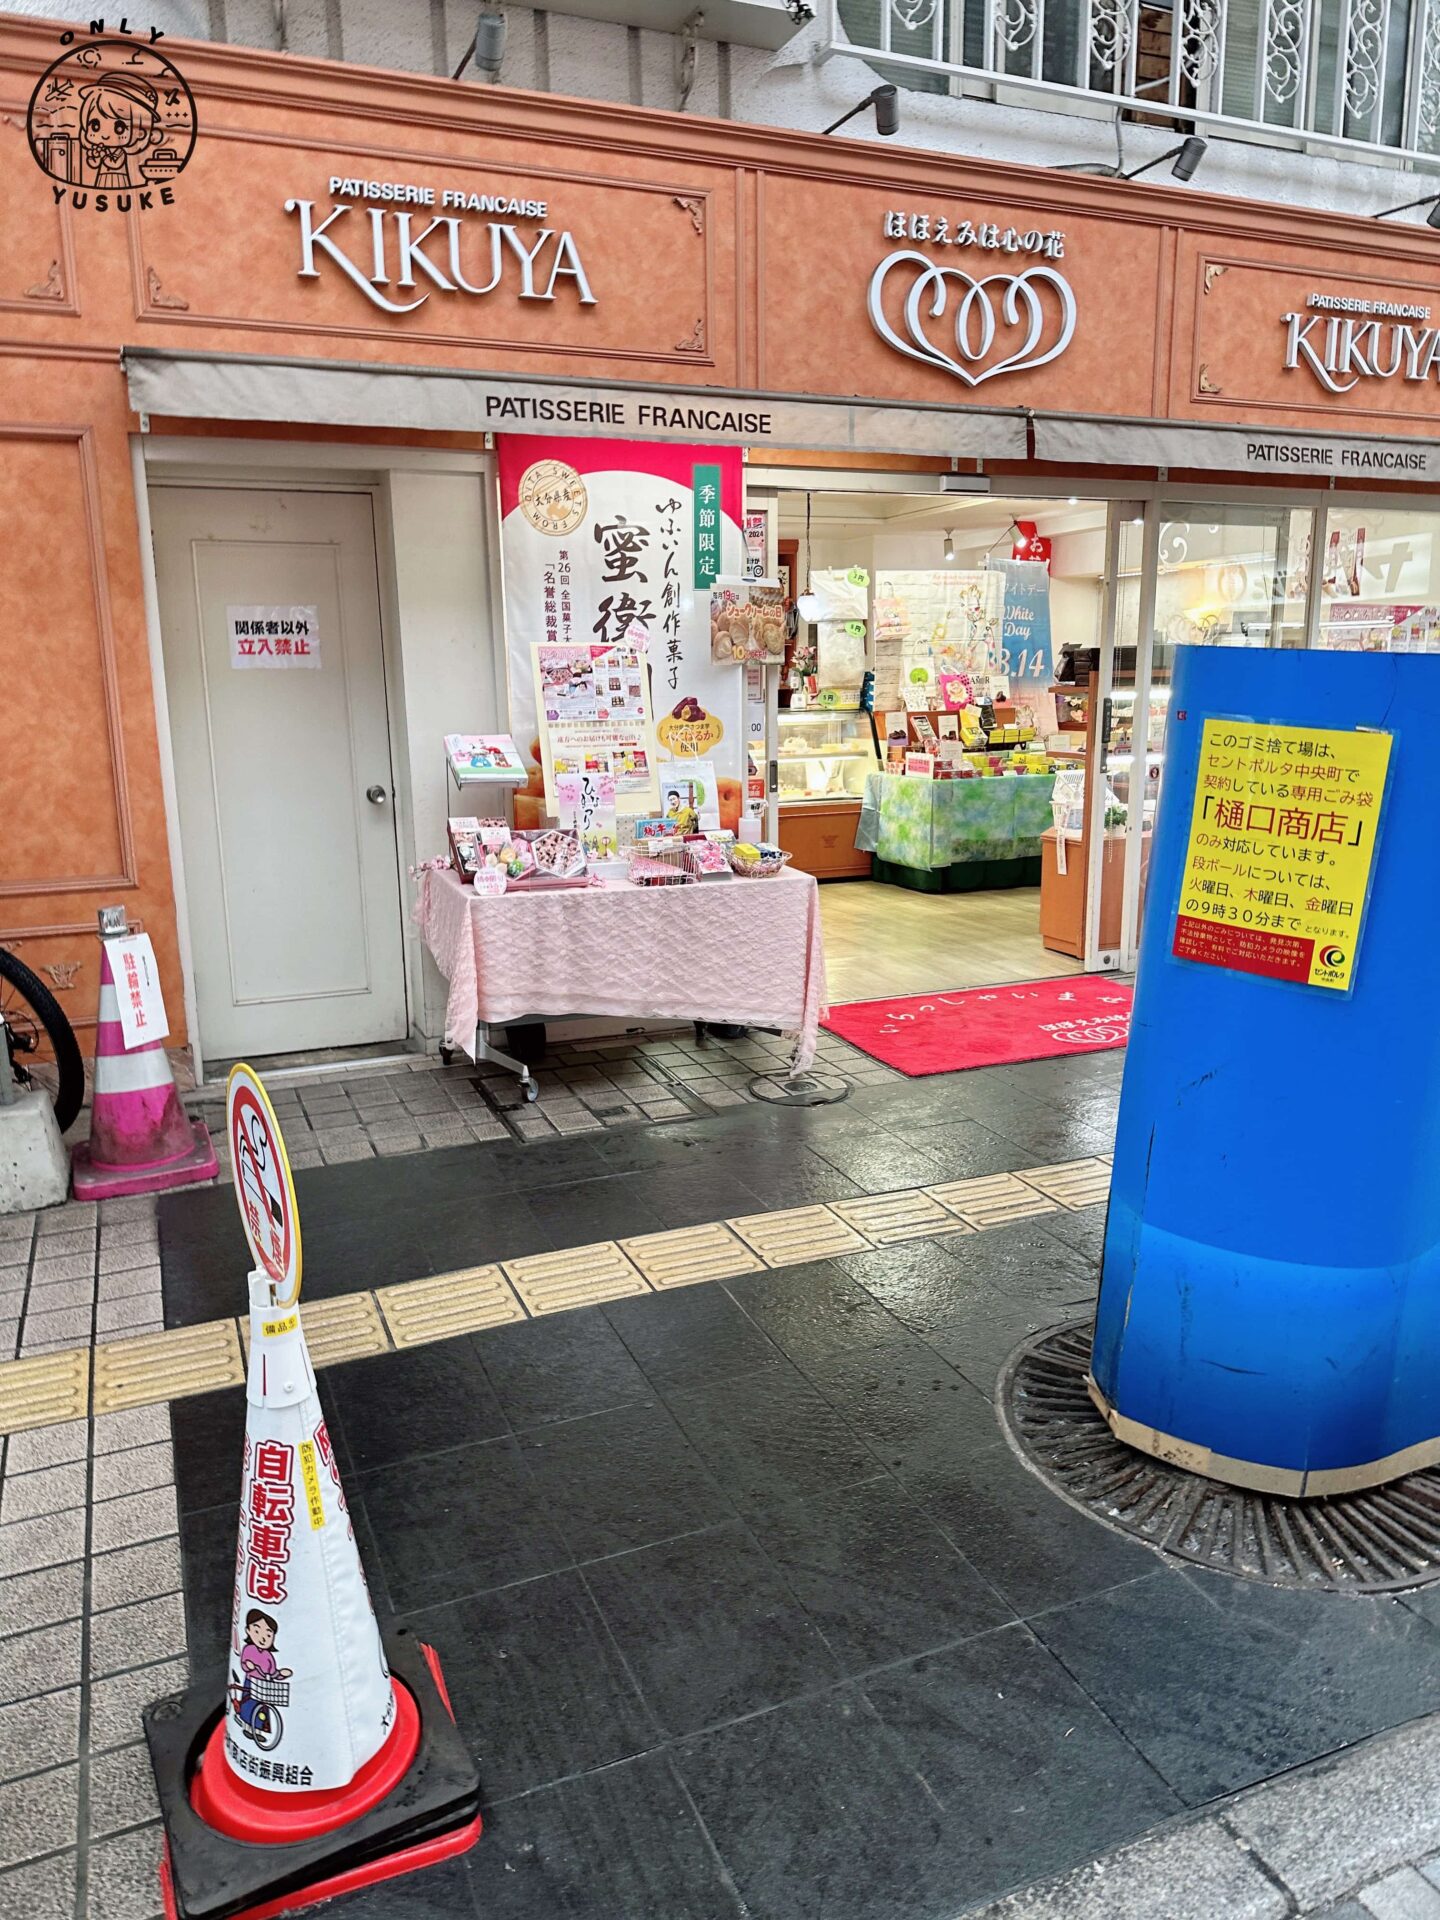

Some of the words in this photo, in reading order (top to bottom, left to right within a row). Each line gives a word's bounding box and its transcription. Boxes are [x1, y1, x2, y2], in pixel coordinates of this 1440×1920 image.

[330, 176, 435, 205] PATISSERIE
[442, 192, 548, 219] FRANCAISE
[883, 211, 1065, 260] ほほえみは心の花
[284, 199, 599, 313] KIKUYA
[1307, 293, 1371, 314] PATISSERIE
[1374, 300, 1431, 320] FRANCAISE
[486, 396, 625, 424] PATISSERIE
[639, 405, 771, 434] FRANCAISE
[1247, 444, 1333, 466] PATISSERIE
[1341, 450, 1427, 471] FRANCAISE
[699, 485, 716, 575] 季節限定
[656, 498, 684, 690] ゆふいん創作菓子
[235, 620, 309, 635] 関係者以外
[238, 638, 310, 655] 立入禁止
[1005, 622, 1031, 640] Day
[1209, 733, 1337, 759] このゴミ捨て場は、
[1207, 753, 1360, 782] セントポルタ中央町で
[1203, 774, 1373, 808] 契約している専用ごみ袋
[1203, 795, 1363, 847] 「樋口商店」
[1196, 832, 1337, 867] のみ対応しています。
[1192, 855, 1332, 891] 段ボールについては、
[123, 952, 147, 1028] 駐輪禁止
[880, 992, 1125, 1034] いらっしゃいませ
[302, 1443, 324, 1527] 防犯カメラ作動中
[246, 1439, 294, 1605] 自転車は
